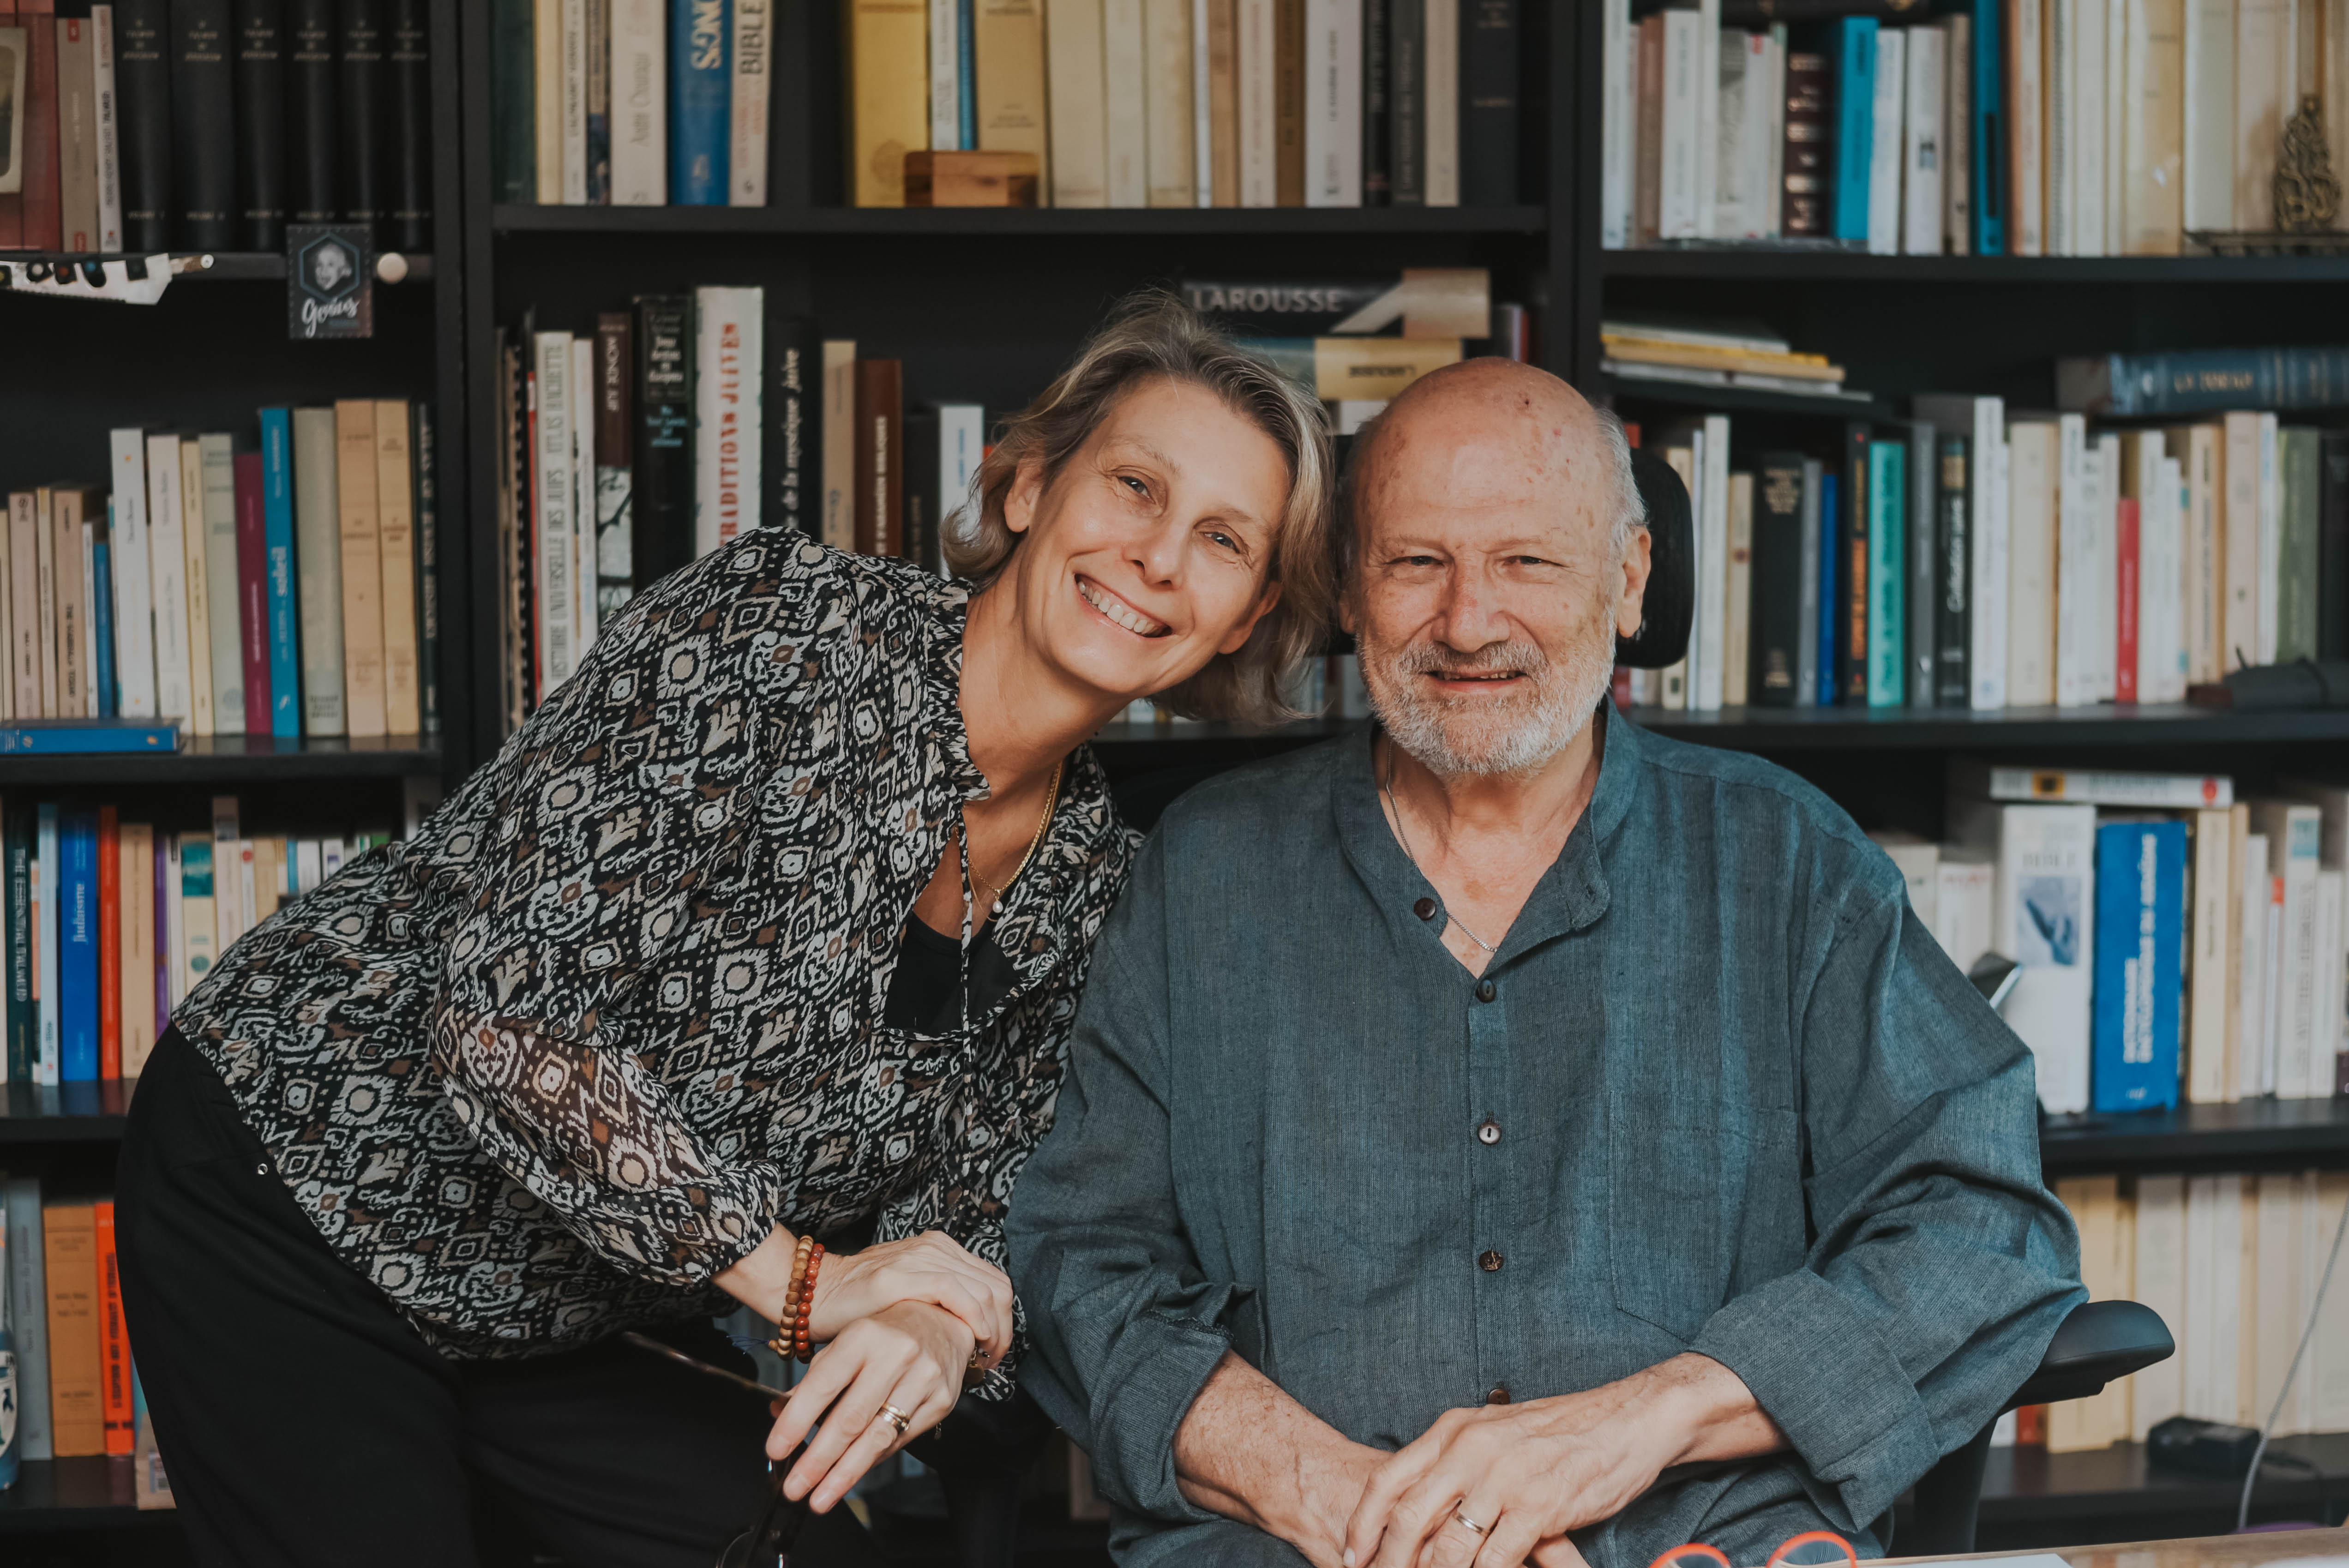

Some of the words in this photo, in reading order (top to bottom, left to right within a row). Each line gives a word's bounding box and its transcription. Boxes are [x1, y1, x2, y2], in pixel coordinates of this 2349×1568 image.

[1193, 287, 1343, 313] LAROUSSE
[544, 346, 563, 412] HACHETTE
[607, 336, 621, 384] MONDE
[720, 323, 739, 404] JUIVES
[546, 469, 565, 505] JUIFS
[270, 546, 288, 597] soleil
[548, 537, 567, 620] UNIVERSELLE
[14, 847, 26, 875] THE
[15, 877, 27, 943] ESSENTIAL
[15, 947, 28, 1001] TALMUD
